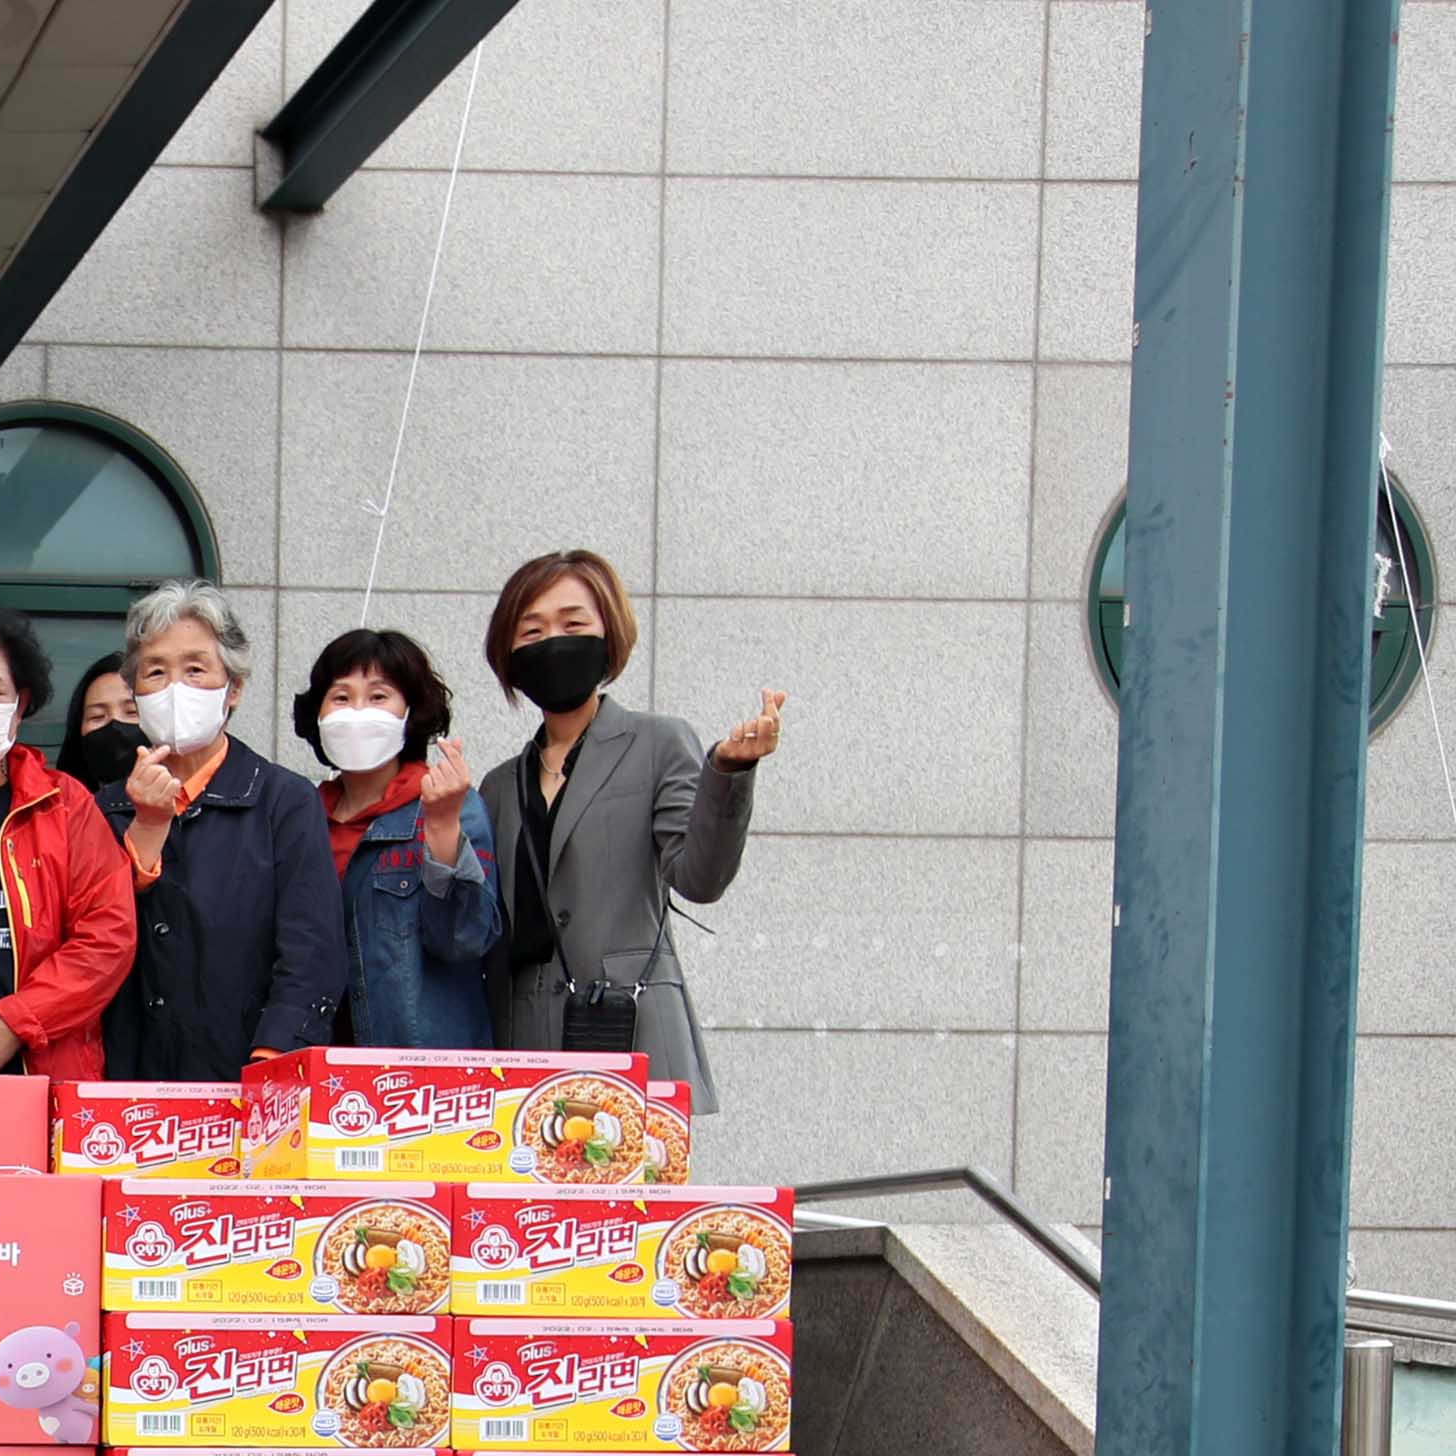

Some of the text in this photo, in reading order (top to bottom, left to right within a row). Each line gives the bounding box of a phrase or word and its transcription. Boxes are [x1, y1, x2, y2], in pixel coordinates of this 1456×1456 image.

[382, 1087, 496, 1139] 진라면
[127, 1117, 238, 1168] 진라면
[181, 1216, 295, 1268] 진라면
[524, 1220, 638, 1272] 진라면
[184, 1350, 298, 1402] 진라면
[526, 1356, 640, 1408] 진라면
